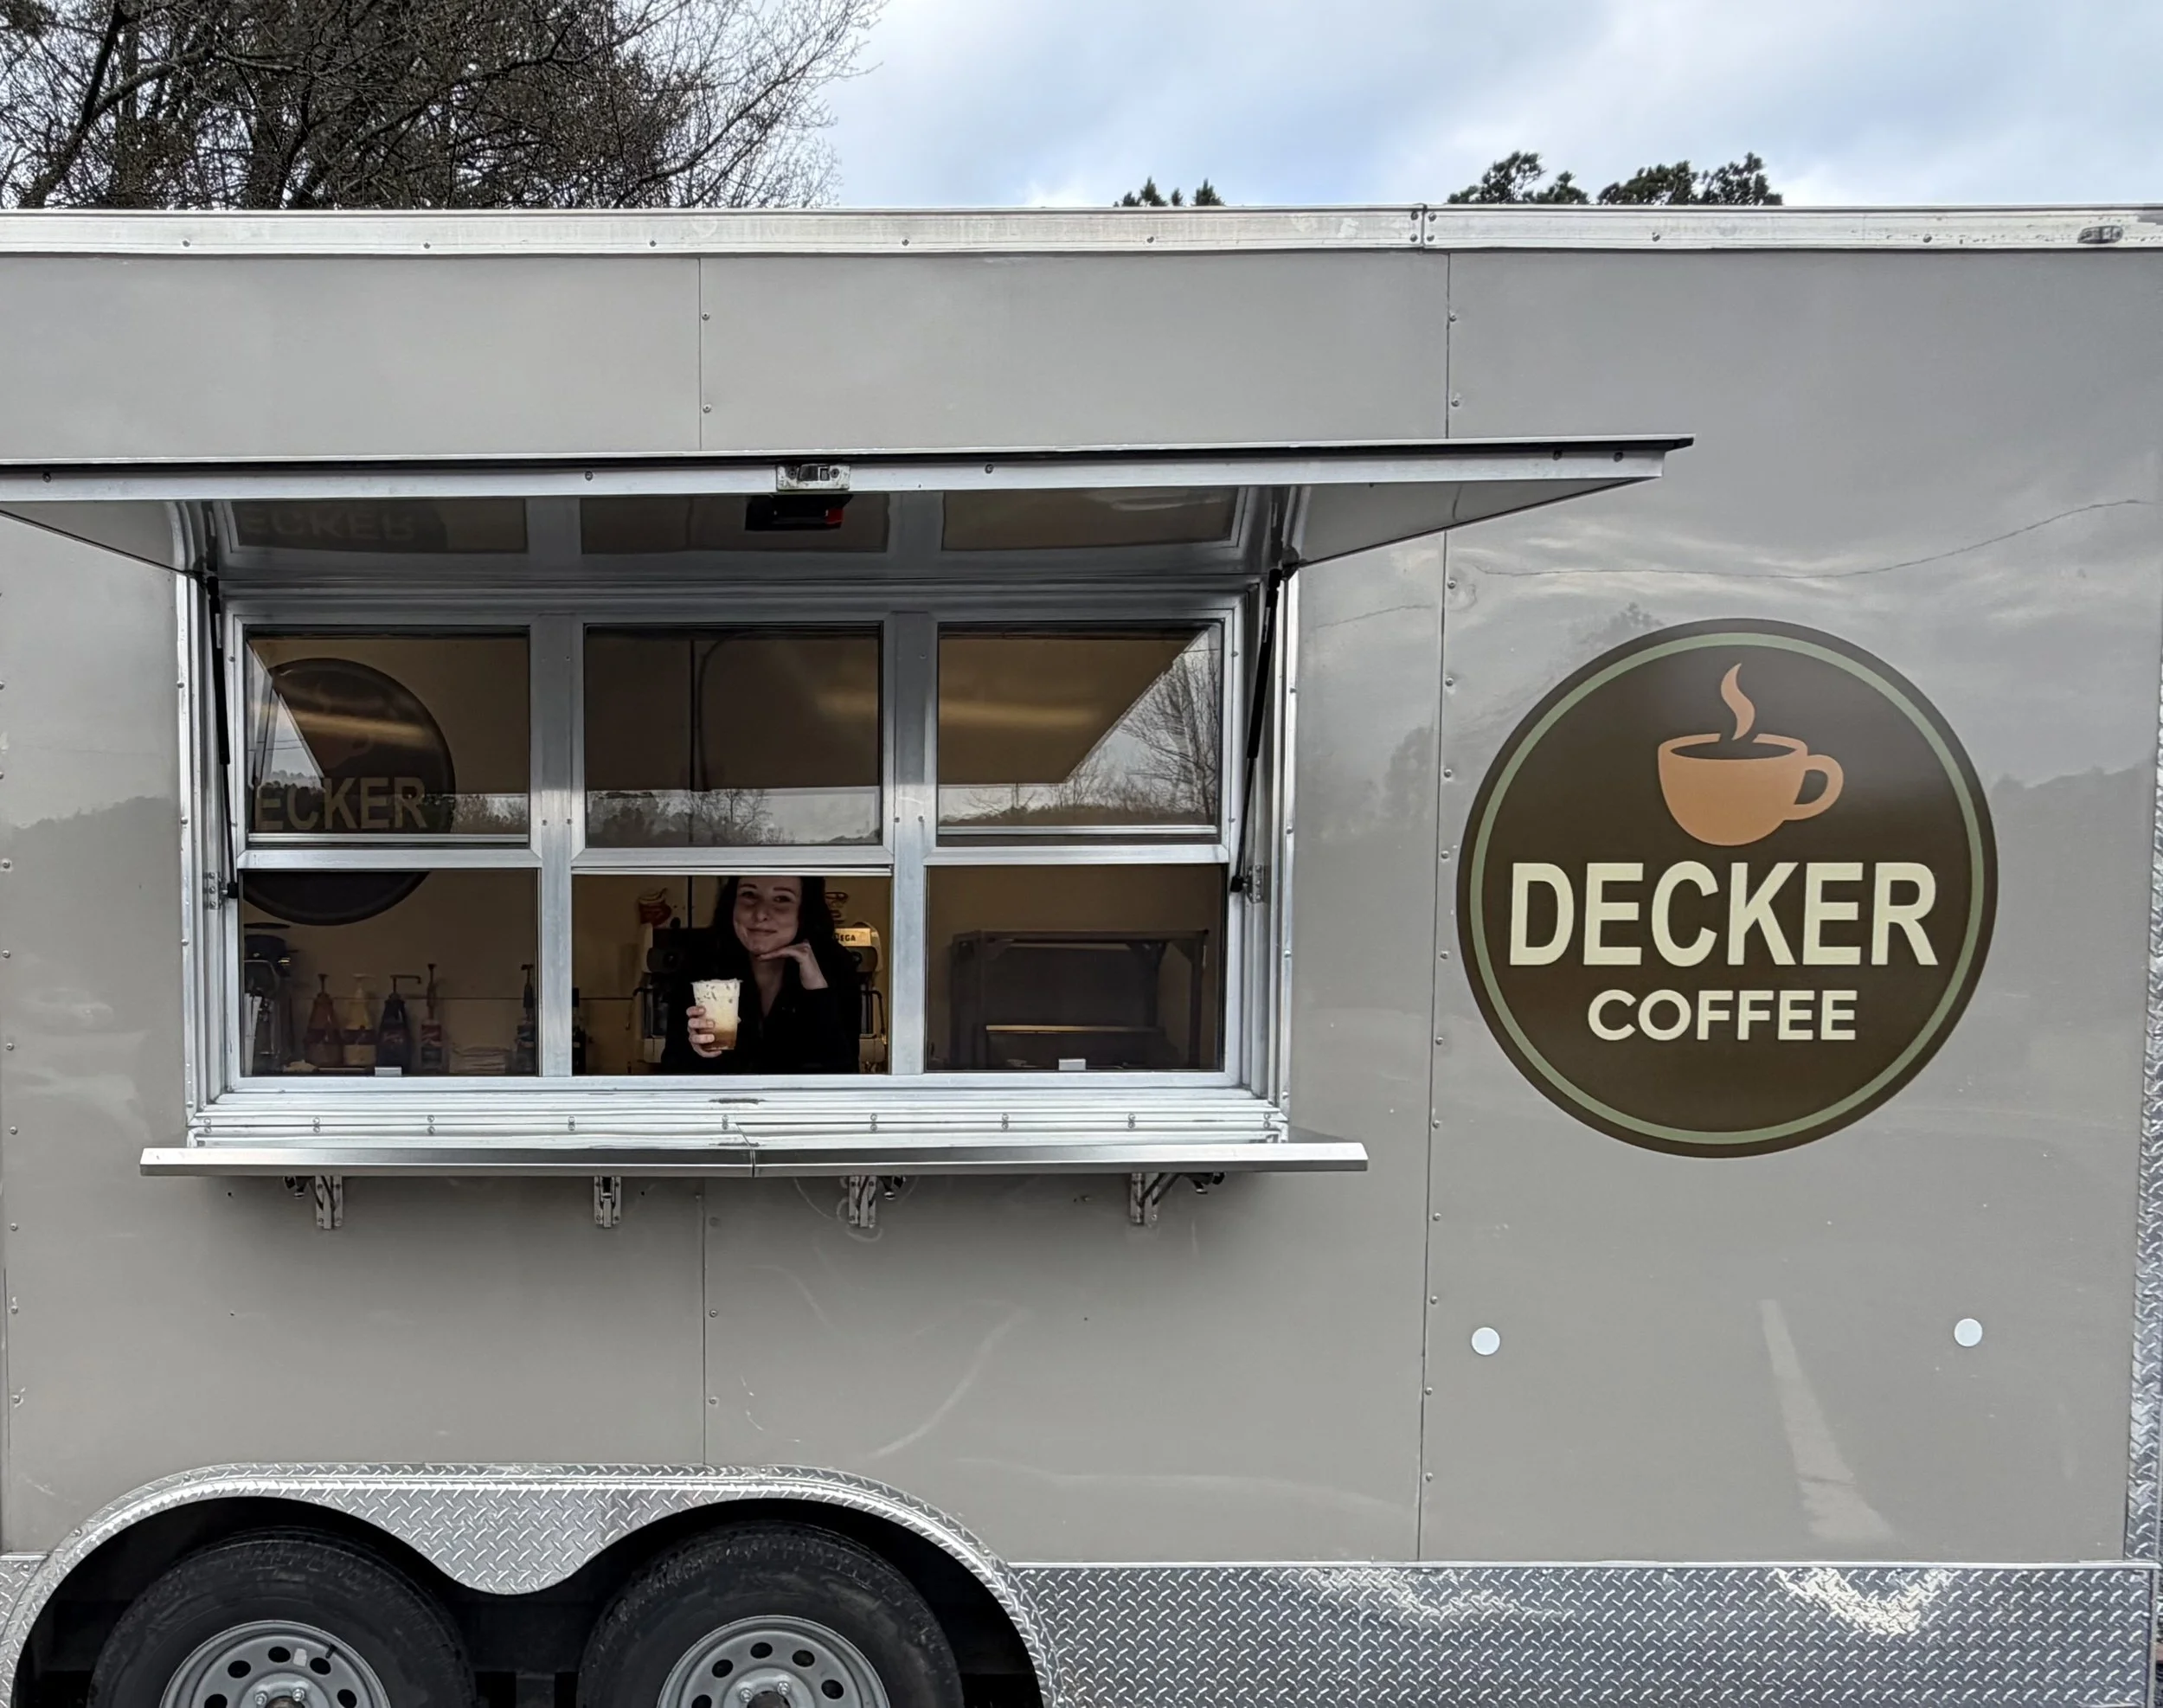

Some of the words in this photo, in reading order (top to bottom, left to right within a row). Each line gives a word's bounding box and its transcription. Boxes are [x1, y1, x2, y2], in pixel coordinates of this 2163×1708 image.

[254, 777, 428, 831] ECKER
[1509, 860, 1939, 967] DECKER
[1588, 989, 1858, 1041] COFFEE
